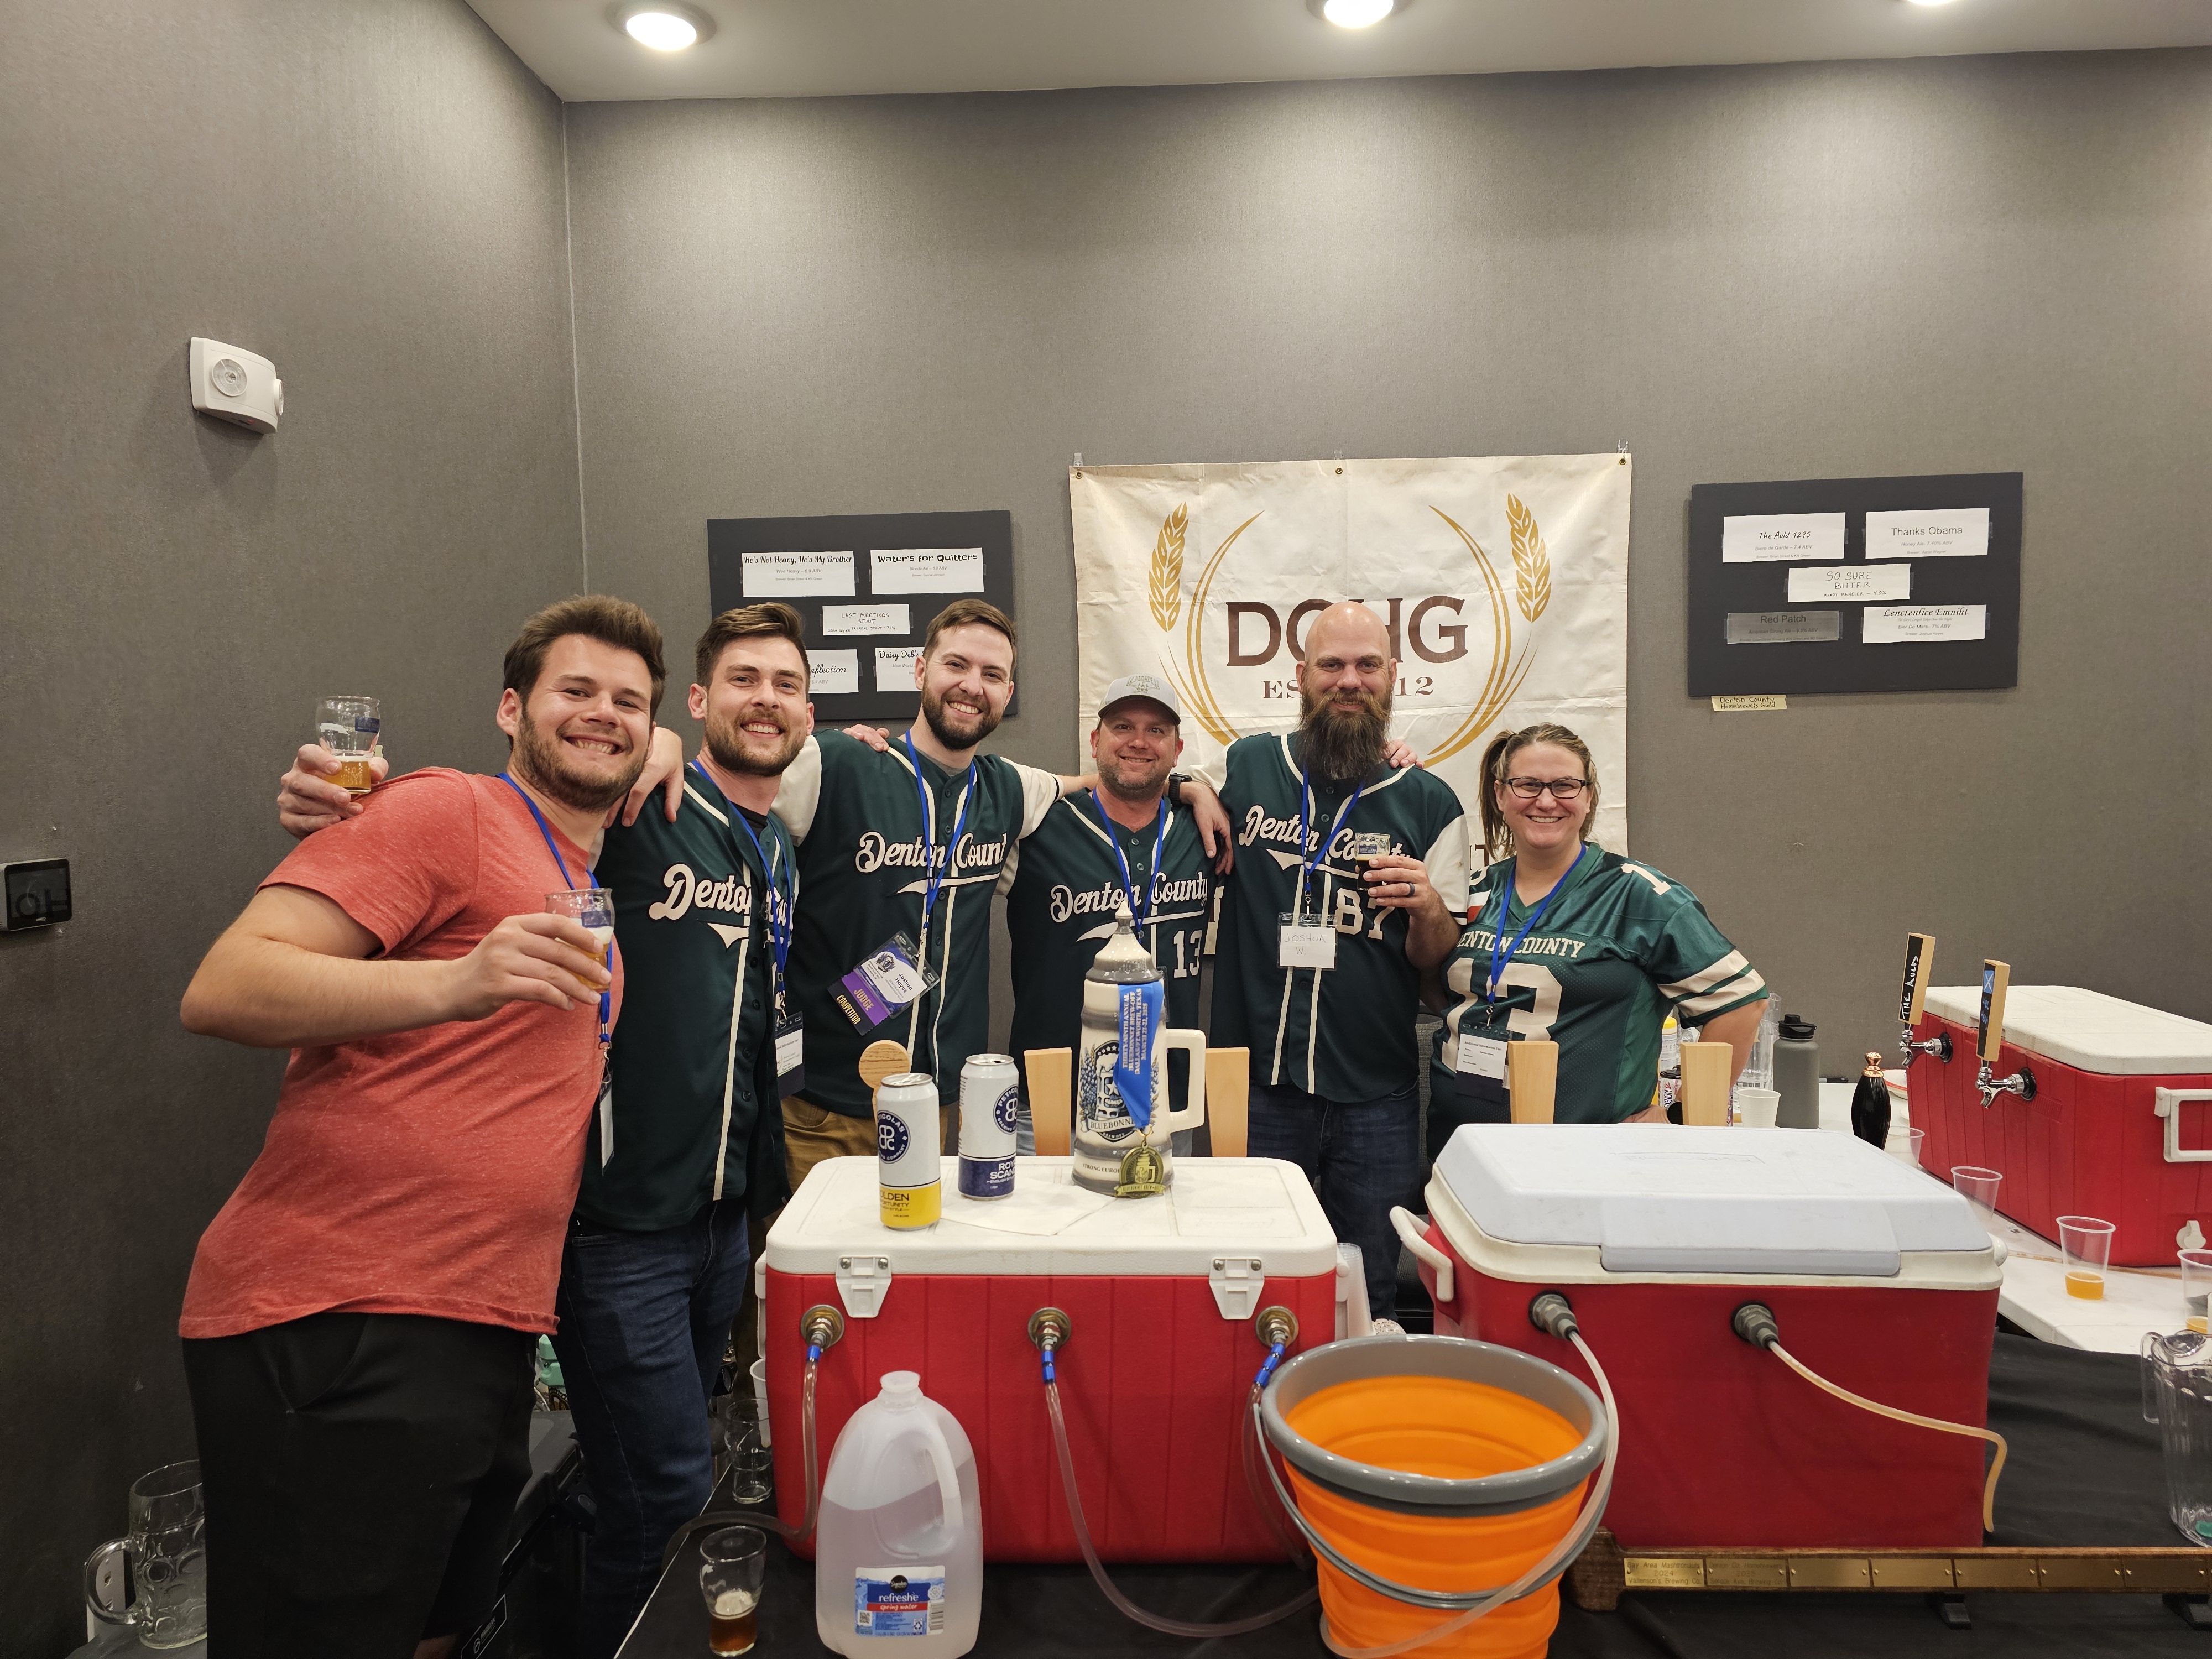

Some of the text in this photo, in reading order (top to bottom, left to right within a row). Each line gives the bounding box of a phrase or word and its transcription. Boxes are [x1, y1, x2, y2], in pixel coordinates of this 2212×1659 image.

[1773, 531, 1791, 539] Auld
[1891, 526, 1963, 536] Thanks Obama
[744, 555, 853, 565] He's Not Heavy, He's My Brother
[937, 554, 978, 563] Quitters
[1825, 571, 1872, 581] SO SURE
[1834, 581, 1870, 589] BITTER
[1760, 614, 1806, 623] Red Patch
[879, 650, 900, 661] Daisy
[810, 664, 847, 677] eflection
[1260, 676, 1434, 700] ES 12
[955, 832, 1006, 869] Count
[1284, 933, 1327, 943] JOSHUA
[1457, 931, 1514, 953] ENTON
[1173, 928, 1203, 978] 13
[895, 978, 907, 993] Hayes
[899, 973, 913, 990] Joshua
[853, 989, 874, 1011] JUDGE
[836, 994, 861, 1025] COMPETITOR
[1900, 992, 1911, 1020] THE
[1090, 1118, 1134, 1129] BLUEBONN
[1082, 1163, 1100, 1171] STRONG
[880, 1190, 910, 1201] OLDEN
[880, 1199, 910, 1207] ORTUNITY
